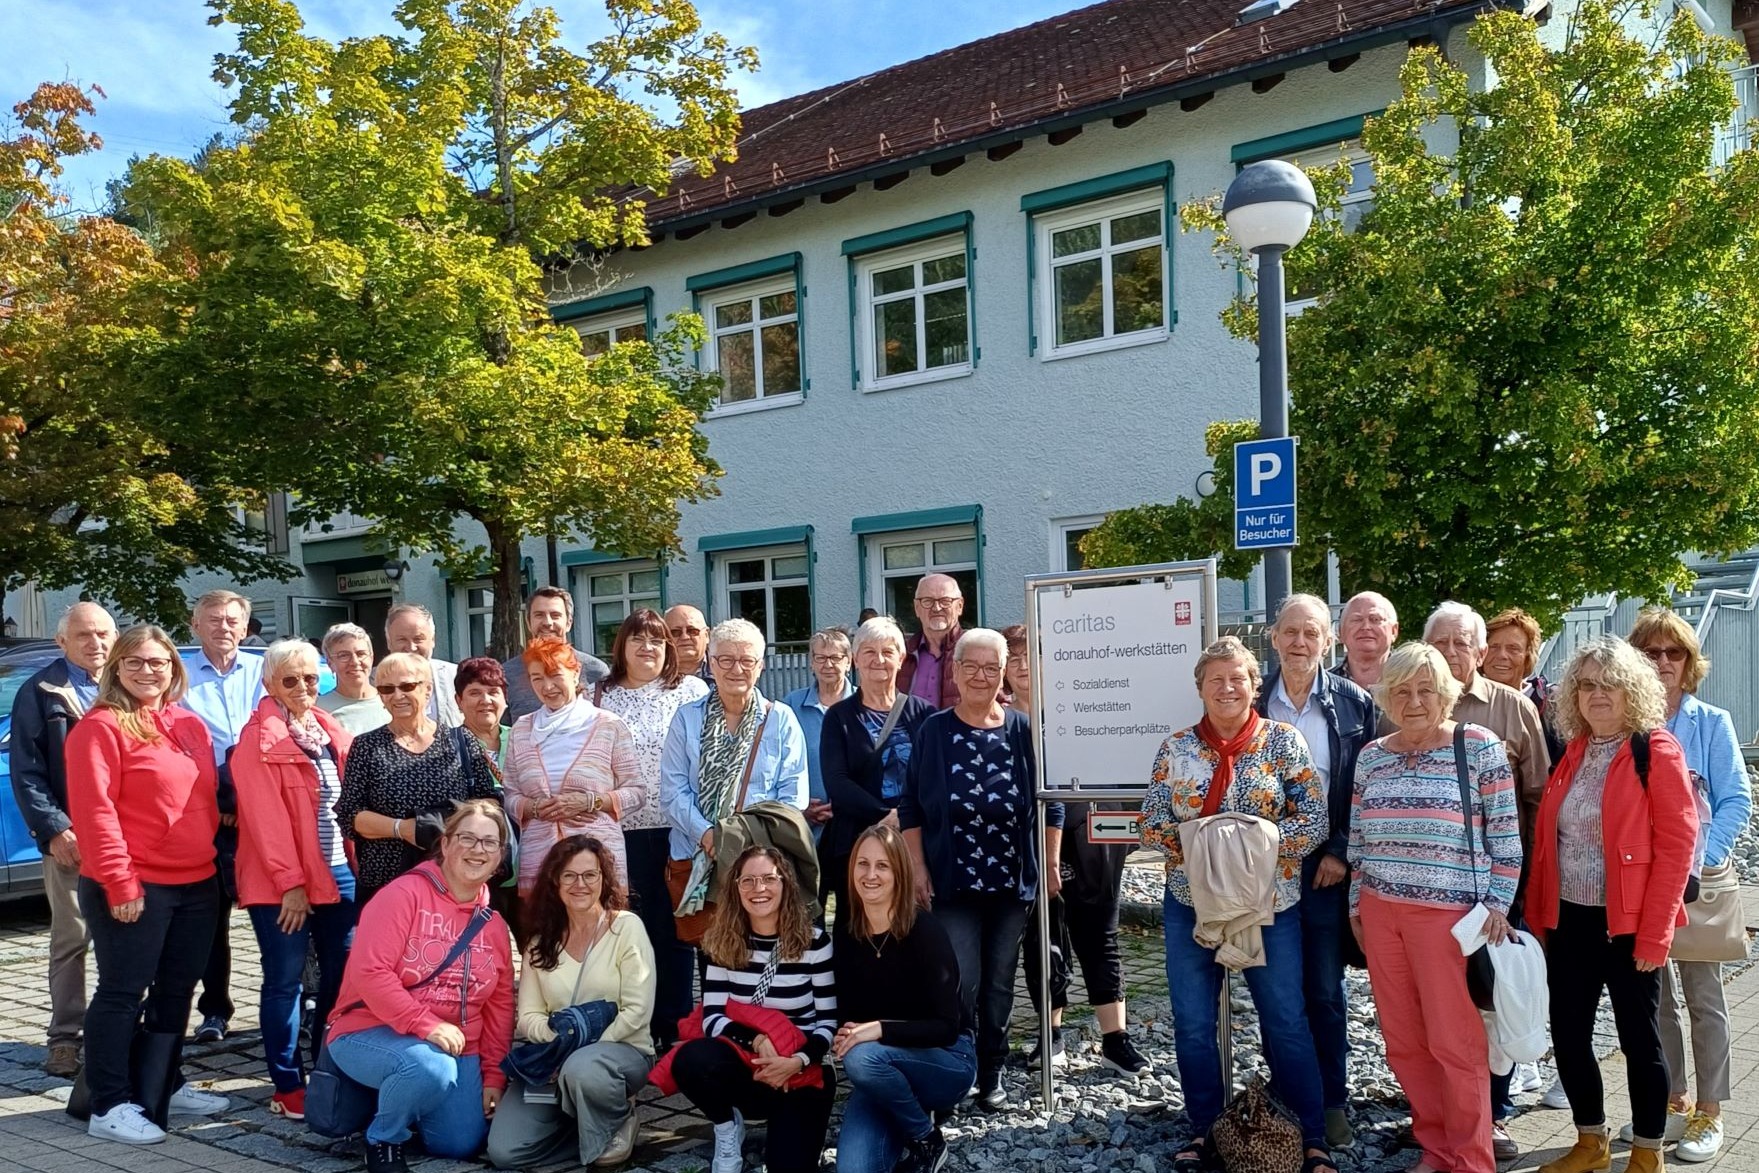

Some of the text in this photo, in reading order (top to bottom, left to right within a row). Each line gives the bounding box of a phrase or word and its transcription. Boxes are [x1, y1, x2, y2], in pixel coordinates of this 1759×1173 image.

[1251, 452, 1282, 496] P
[1245, 513, 1286, 527] Nur für
[1240, 527, 1292, 541] Besucher
[1053, 613, 1116, 634] caritas
[1053, 642, 1188, 661] donauhof-werkstätten
[1072, 678, 1130, 690] Sozialdienst
[1073, 702, 1132, 713] Werkstätten
[1074, 723, 1171, 737] Besucherparkplätze
